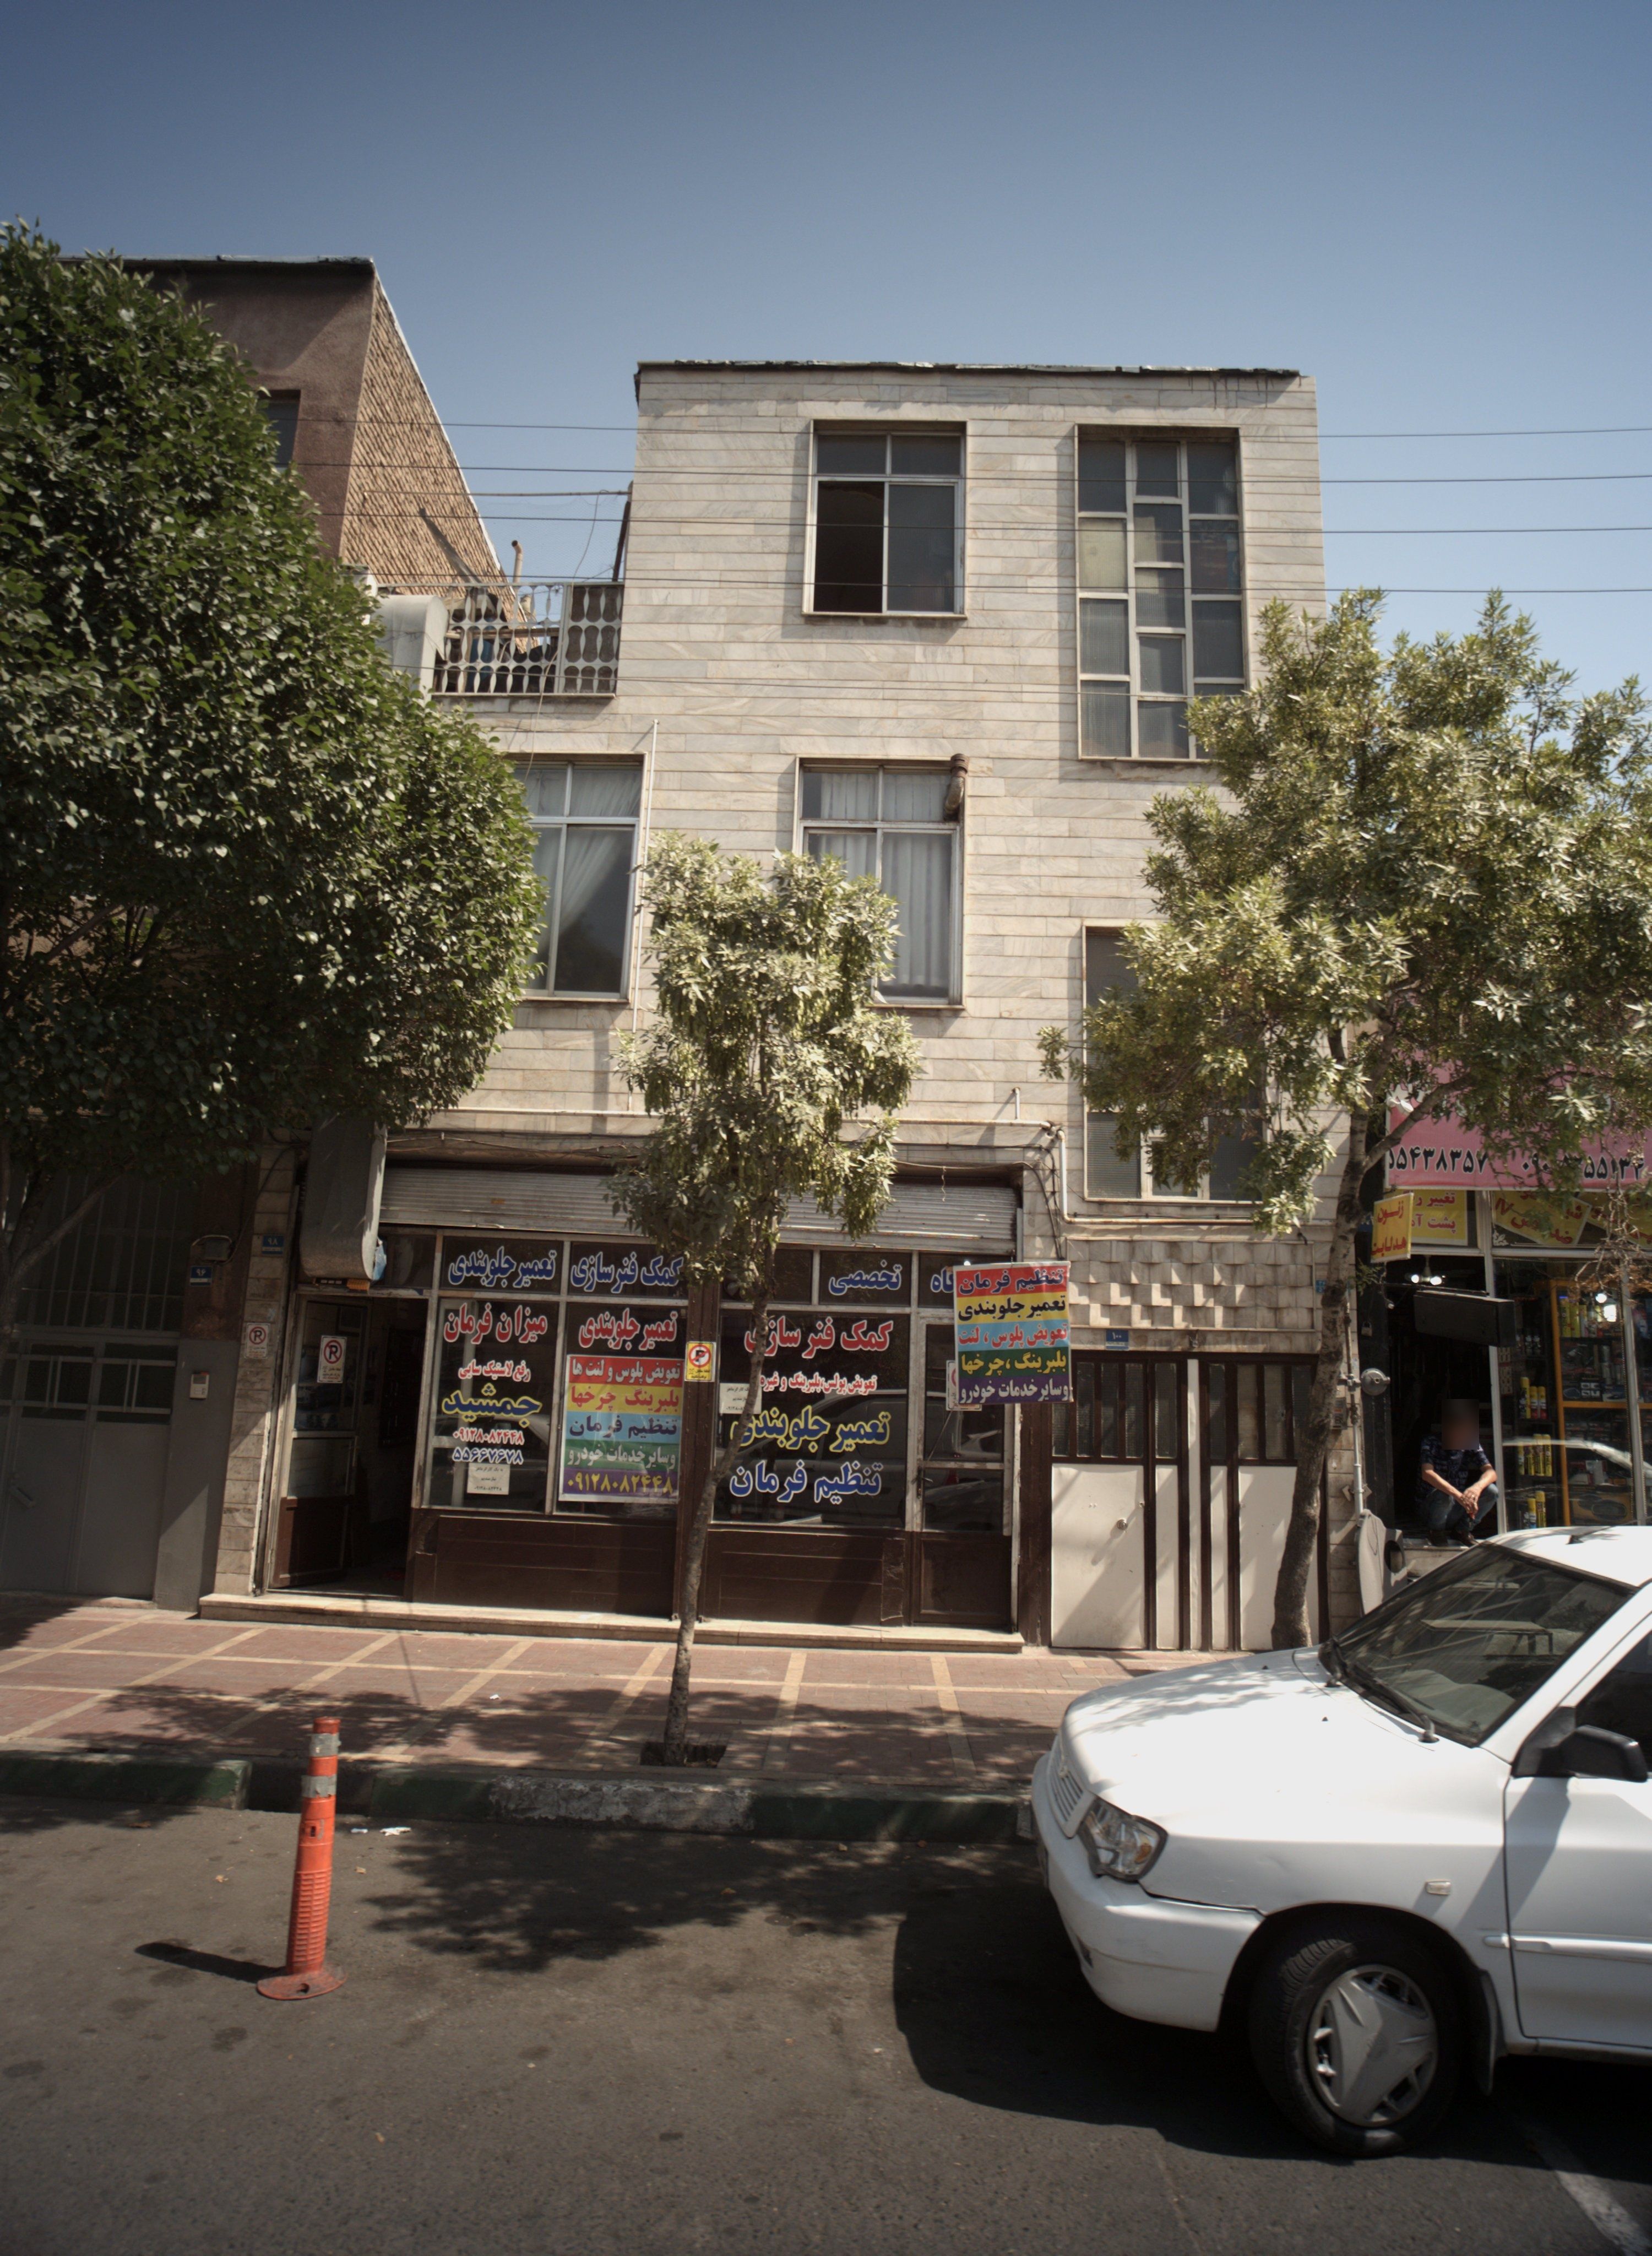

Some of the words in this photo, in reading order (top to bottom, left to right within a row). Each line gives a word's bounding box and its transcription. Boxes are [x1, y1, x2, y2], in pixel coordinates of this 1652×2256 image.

[1426, 1192, 1455, 1207] تغییر
[1427, 1217, 1456, 1234] پشت
[448, 1246, 517, 1287] جلوبندی
[513, 1250, 558, 1288] تعمیر
[570, 1251, 615, 1292] سازی
[611, 1251, 638, 1293] فنر
[640, 1255, 684, 1287] کمک
[828, 1259, 903, 1295] تخصصی
[959, 1269, 1010, 1294] فرمان
[1015, 1268, 1066, 1292] تنظیم
[958, 1297, 1025, 1321] جلوبندی
[1025, 1294, 1066, 1319] تعمیر
[444, 1302, 493, 1344] فرمان
[496, 1305, 547, 1343] میزان
[579, 1307, 641, 1351] جلوبندی
[638, 1311, 678, 1351] تعمیر
[840, 1319, 894, 1351] کمک
[958, 1326, 980, 1344] لنت
[1026, 1323, 1068, 1347] تعویض
[802, 1316, 836, 1359] فنر
[991, 1325, 1024, 1349] پلوس
[482, 1360, 514, 1380] لاستیک
[513, 1360, 531, 1382] رفع
[572, 1358, 583, 1375] ها
[585, 1359, 605, 1376] لنت
[607, 1366, 613, 1382] و
[615, 1360, 643, 1384] پلوس
[645, 1362, 681, 1384] تعویض
[1014, 1350, 1067, 1374] بلبرینگ
[759, 1371, 780, 1392] غیره
[780, 1376, 787, 1392] و
[847, 1374, 878, 1396] تعویض
[959, 1379, 996, 1403] خودرو
[998, 1379, 1037, 1397] خدمات
[441, 1382, 542, 1428] جمشید
[624, 1389, 679, 1413] بلبرینگ
[569, 1415, 622, 1438] فرمان
[628, 1417, 677, 1439] تنظیم
[829, 1411, 891, 1452] تعمیر
[452, 1446, 524, 1465] ۵۵۶۶۷۶۷۸
[567, 1444, 604, 1466] خودرو
[607, 1444, 645, 1462] خدمات
[568, 1472, 673, 1494] ۰۹۱۲۸۰۸۲۴۴۸
[730, 1459, 807, 1503] فرمان
[814, 1461, 883, 1505] تنظیم
